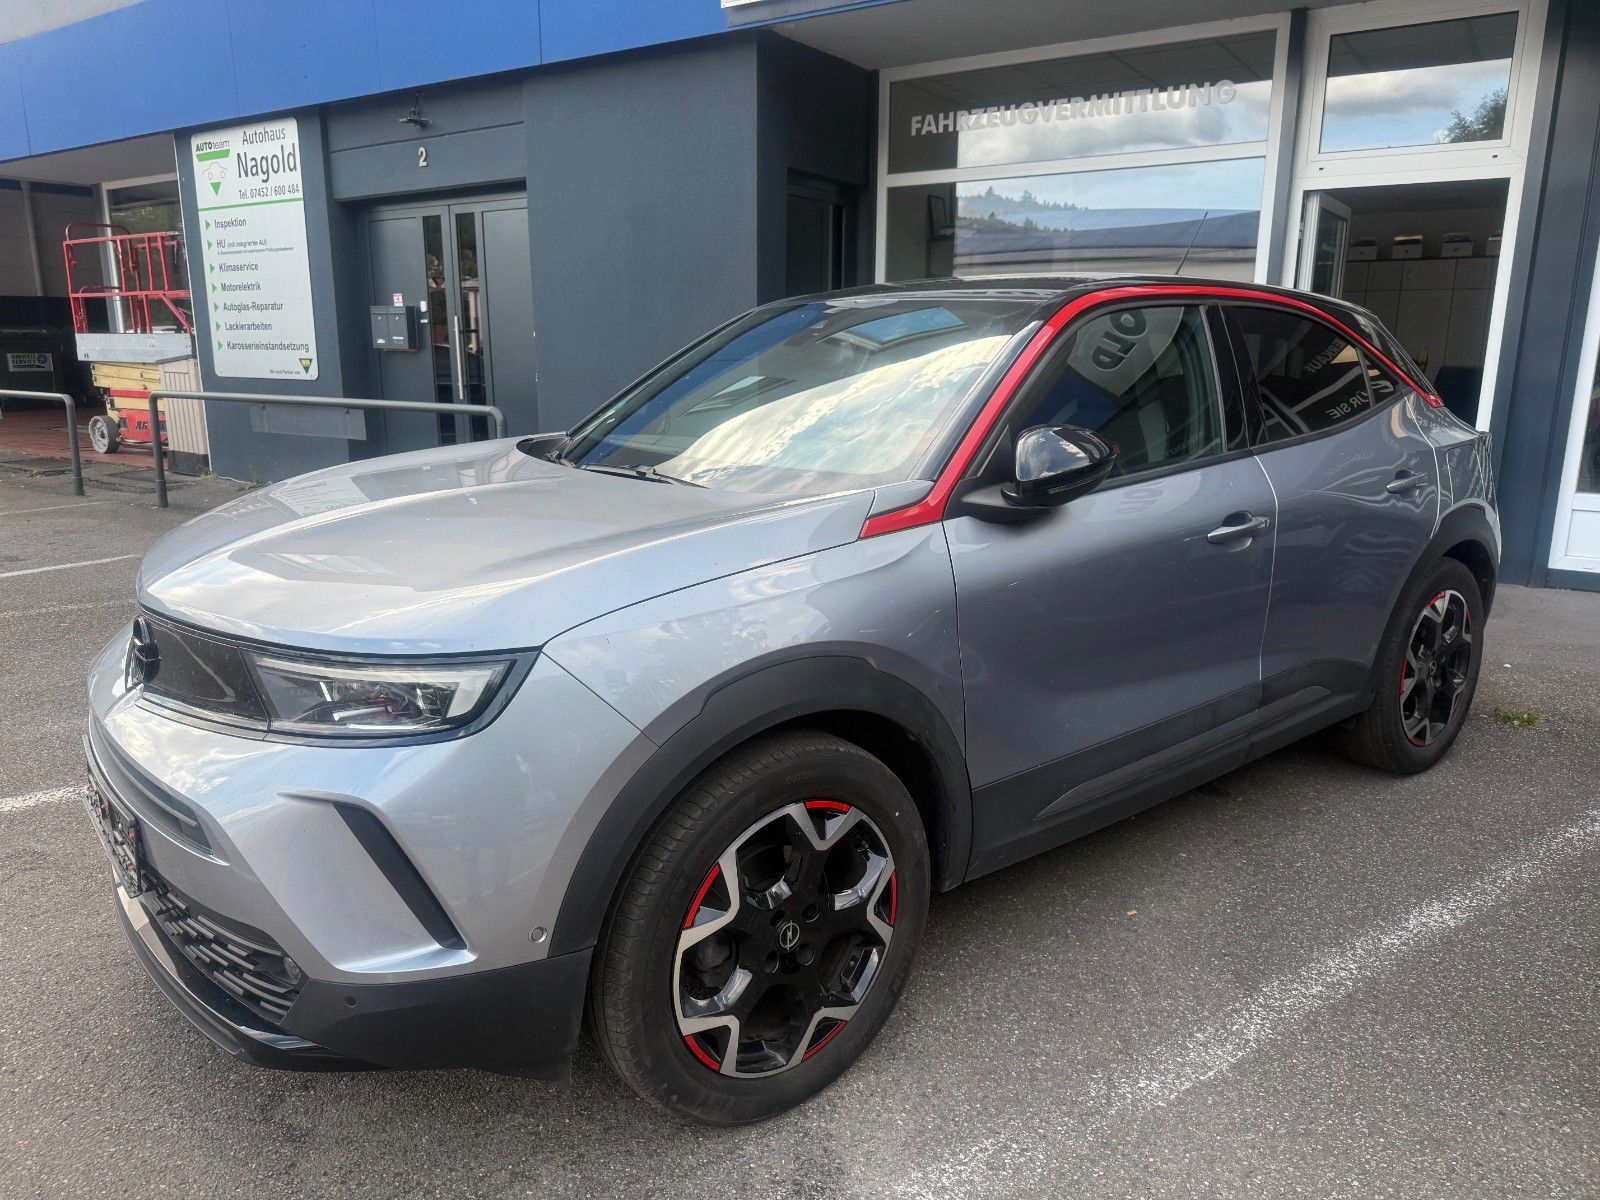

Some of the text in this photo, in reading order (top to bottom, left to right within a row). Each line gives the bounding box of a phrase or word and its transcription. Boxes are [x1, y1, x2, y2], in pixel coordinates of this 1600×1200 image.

[909, 79, 1238, 137] FAHRZEUGVERMITTLUNG
[242, 126, 286, 146] Autohaus
[195, 140, 230, 153] AUTOteam
[236, 143, 298, 183] Nagold
[418, 147, 428, 167] 2
[238, 190, 249, 200] Tel.
[250, 187, 268, 199] 07452
[274, 185, 286, 196] 600
[287, 183, 300, 194] 484
[214, 217, 247, 231] Inspektion
[216, 239, 226, 248] HU
[218, 261, 259, 273] Klimaservice
[220, 281, 261, 292] Motorelektrik
[223, 301, 284, 313] Autoglas-Reparatur
[224, 321, 273, 332] Lackierarbeiten
[226, 340, 310, 353] Karosserieinstandsetzung
